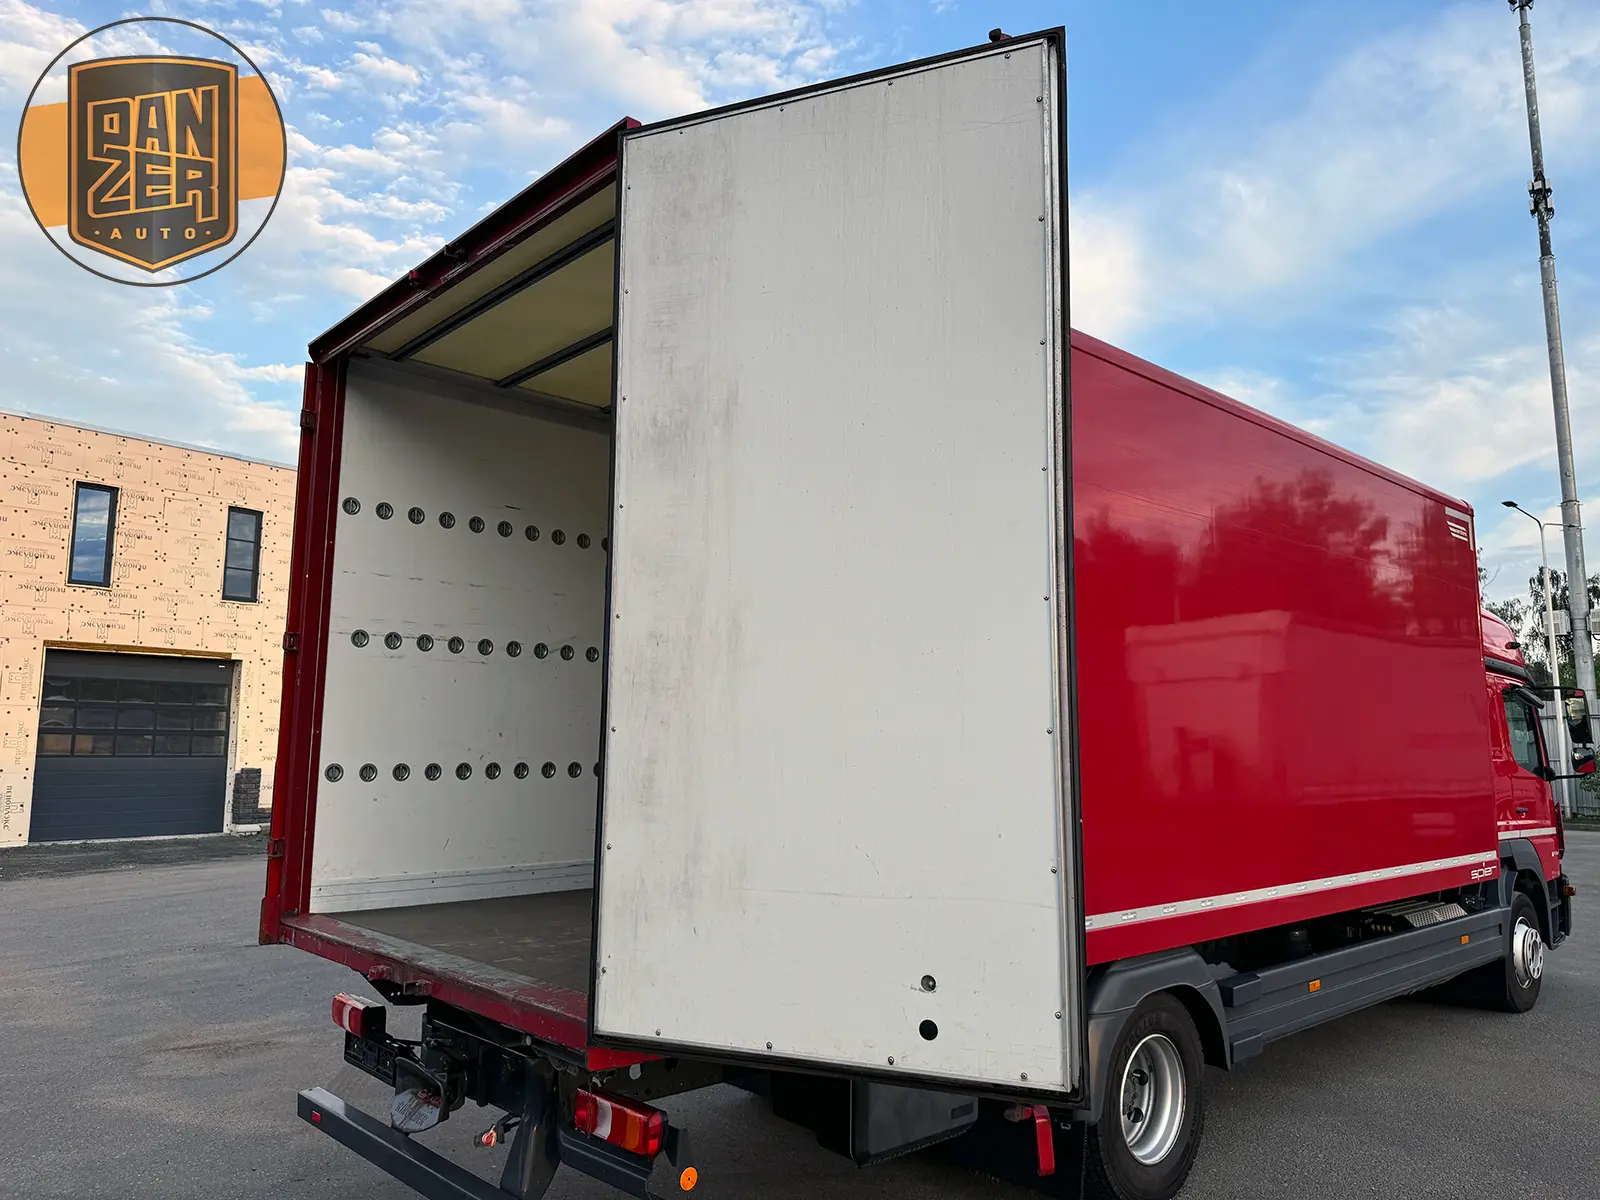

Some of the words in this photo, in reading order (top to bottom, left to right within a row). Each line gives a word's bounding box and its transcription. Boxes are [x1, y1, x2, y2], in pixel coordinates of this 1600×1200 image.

[164, 470, 205, 481] ПЕНОЛЭКС
[213, 603, 252, 611] ПЕНПЛЭКС
[80, 621, 126, 629] ПЕНПЛЭКС
